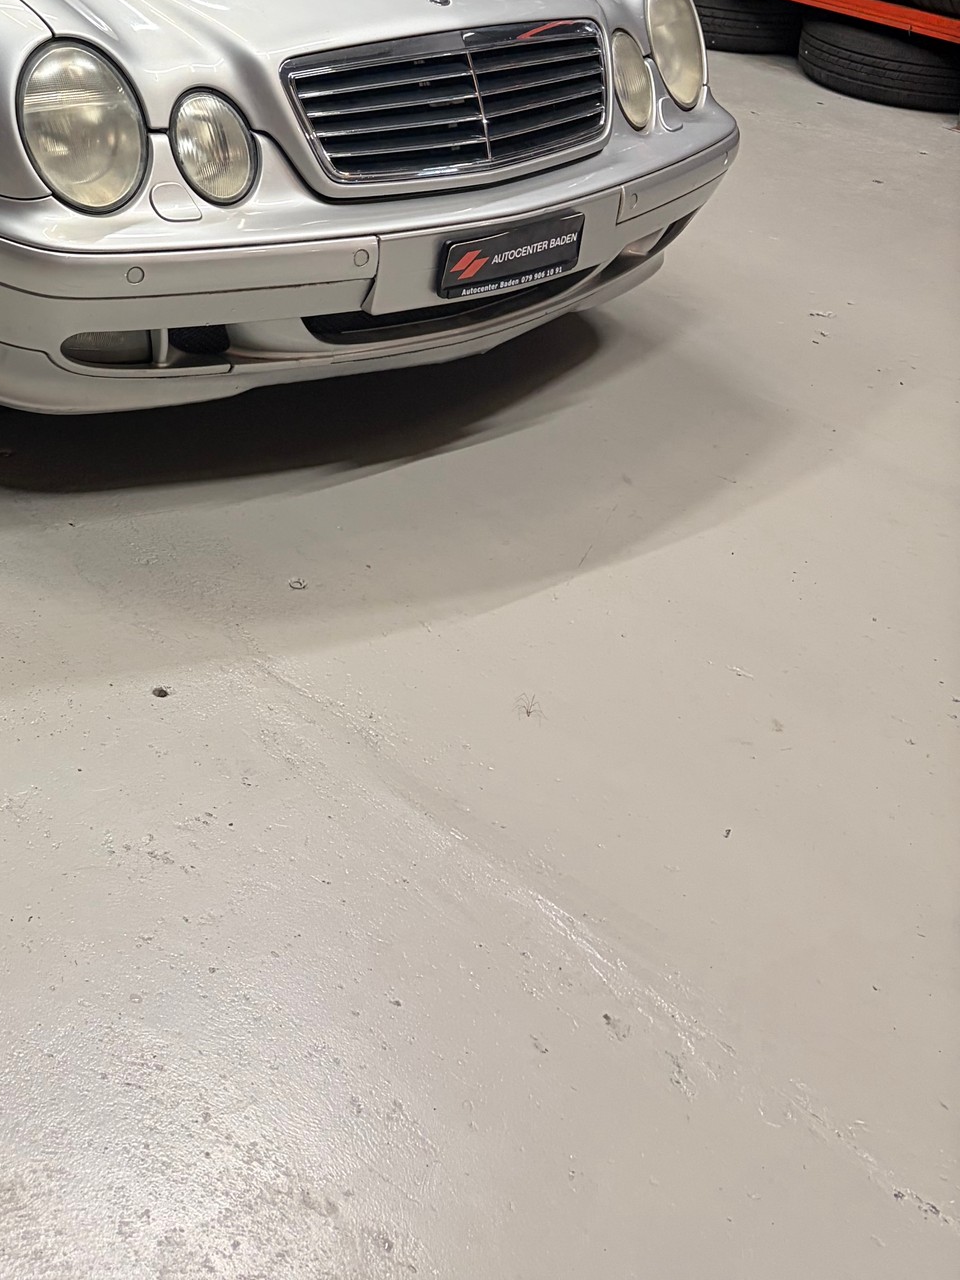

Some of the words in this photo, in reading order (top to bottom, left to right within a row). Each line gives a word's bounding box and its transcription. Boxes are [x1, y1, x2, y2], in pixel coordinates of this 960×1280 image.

[491, 240, 548, 265] AUTOCENTER
[549, 232, 578, 249] BADEN
[461, 284, 499, 296] Autocenter
[500, 278, 519, 289] Baden
[521, 274, 533, 284] 079
[546, 268, 554, 277] 10
[555, 266, 562, 274] 91
